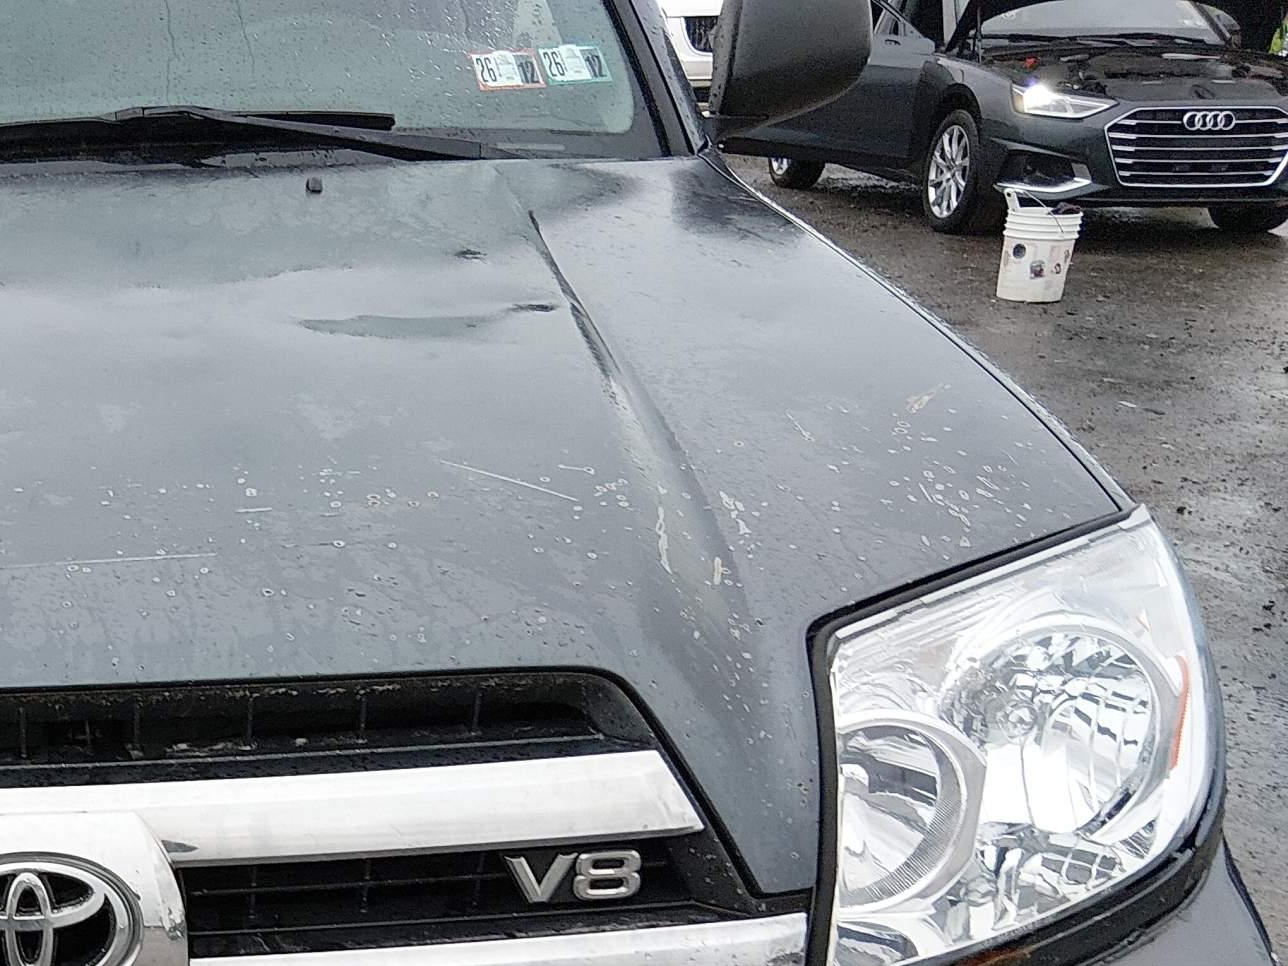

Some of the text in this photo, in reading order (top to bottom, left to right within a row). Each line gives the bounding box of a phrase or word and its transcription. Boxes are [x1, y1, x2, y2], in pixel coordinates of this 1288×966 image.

[476, 57, 497, 82] 26
[543, 51, 566, 77] 26
[504, 850, 642, 904] V8
